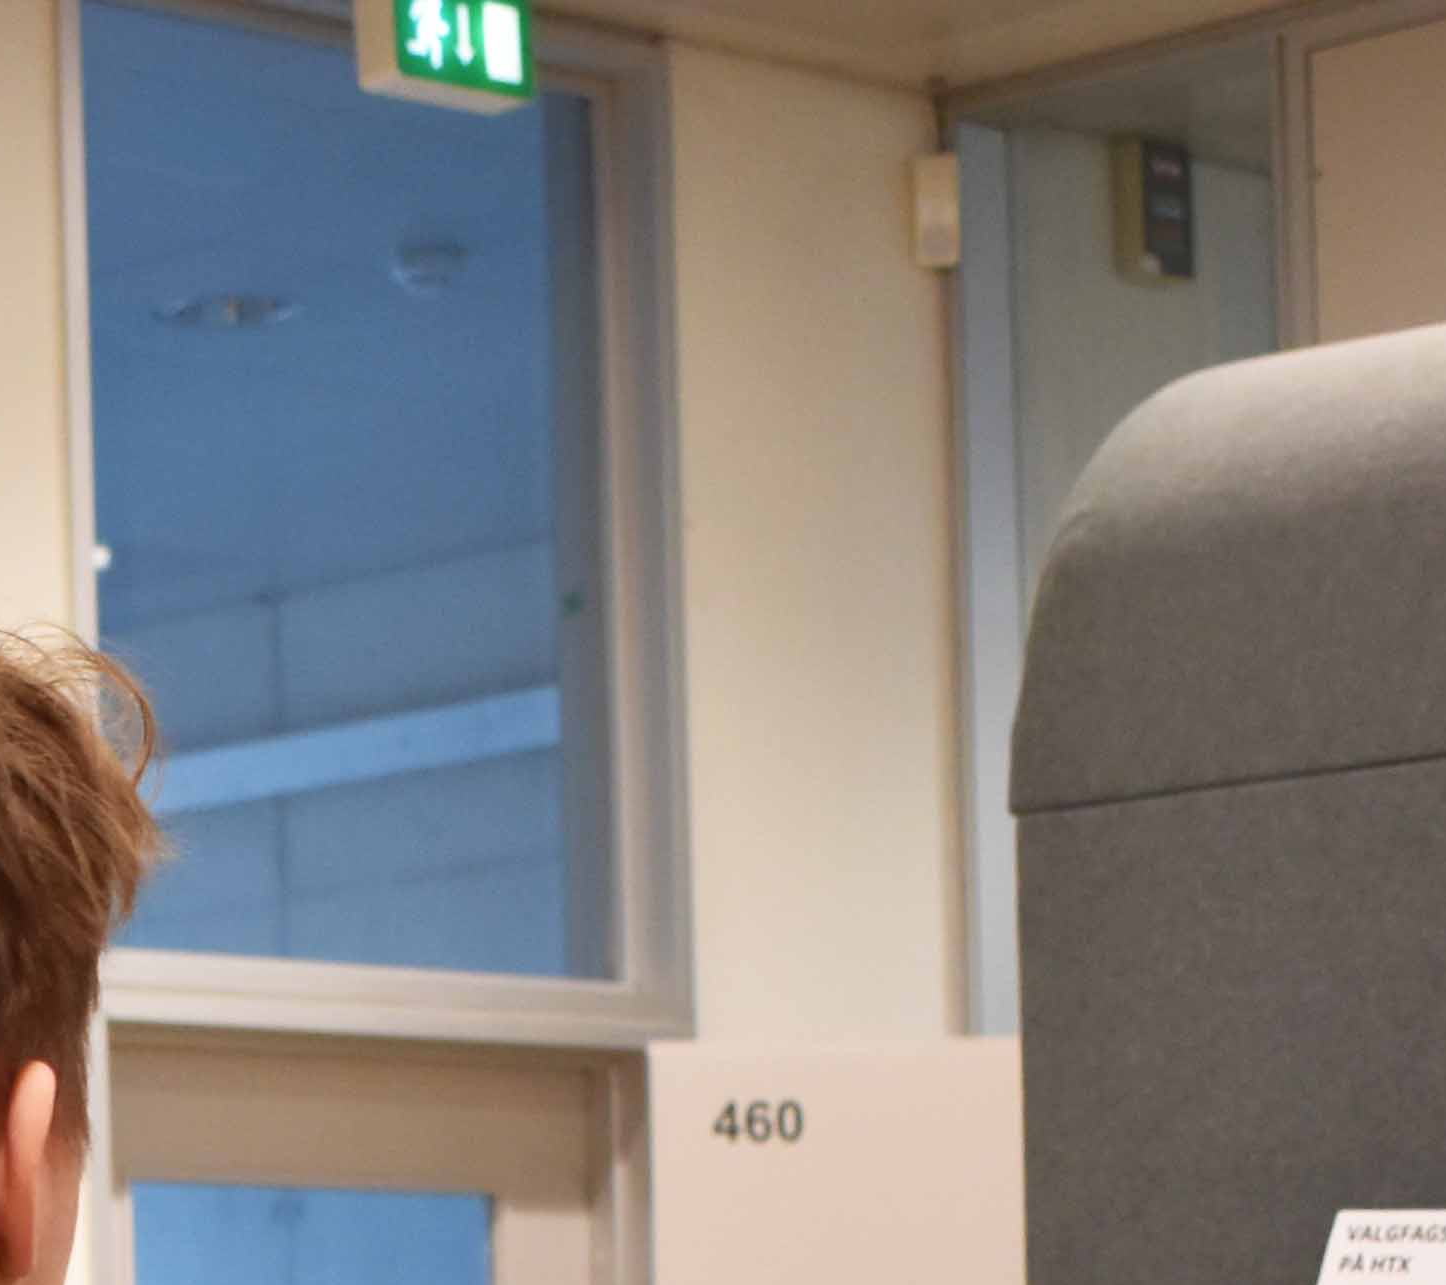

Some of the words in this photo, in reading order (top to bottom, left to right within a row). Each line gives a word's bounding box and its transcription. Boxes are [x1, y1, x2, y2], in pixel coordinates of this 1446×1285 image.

[712, 1100, 805, 1143] 460
[1337, 1252, 1365, 1274] PÅ
[1369, 1255, 1412, 1274] HTX
